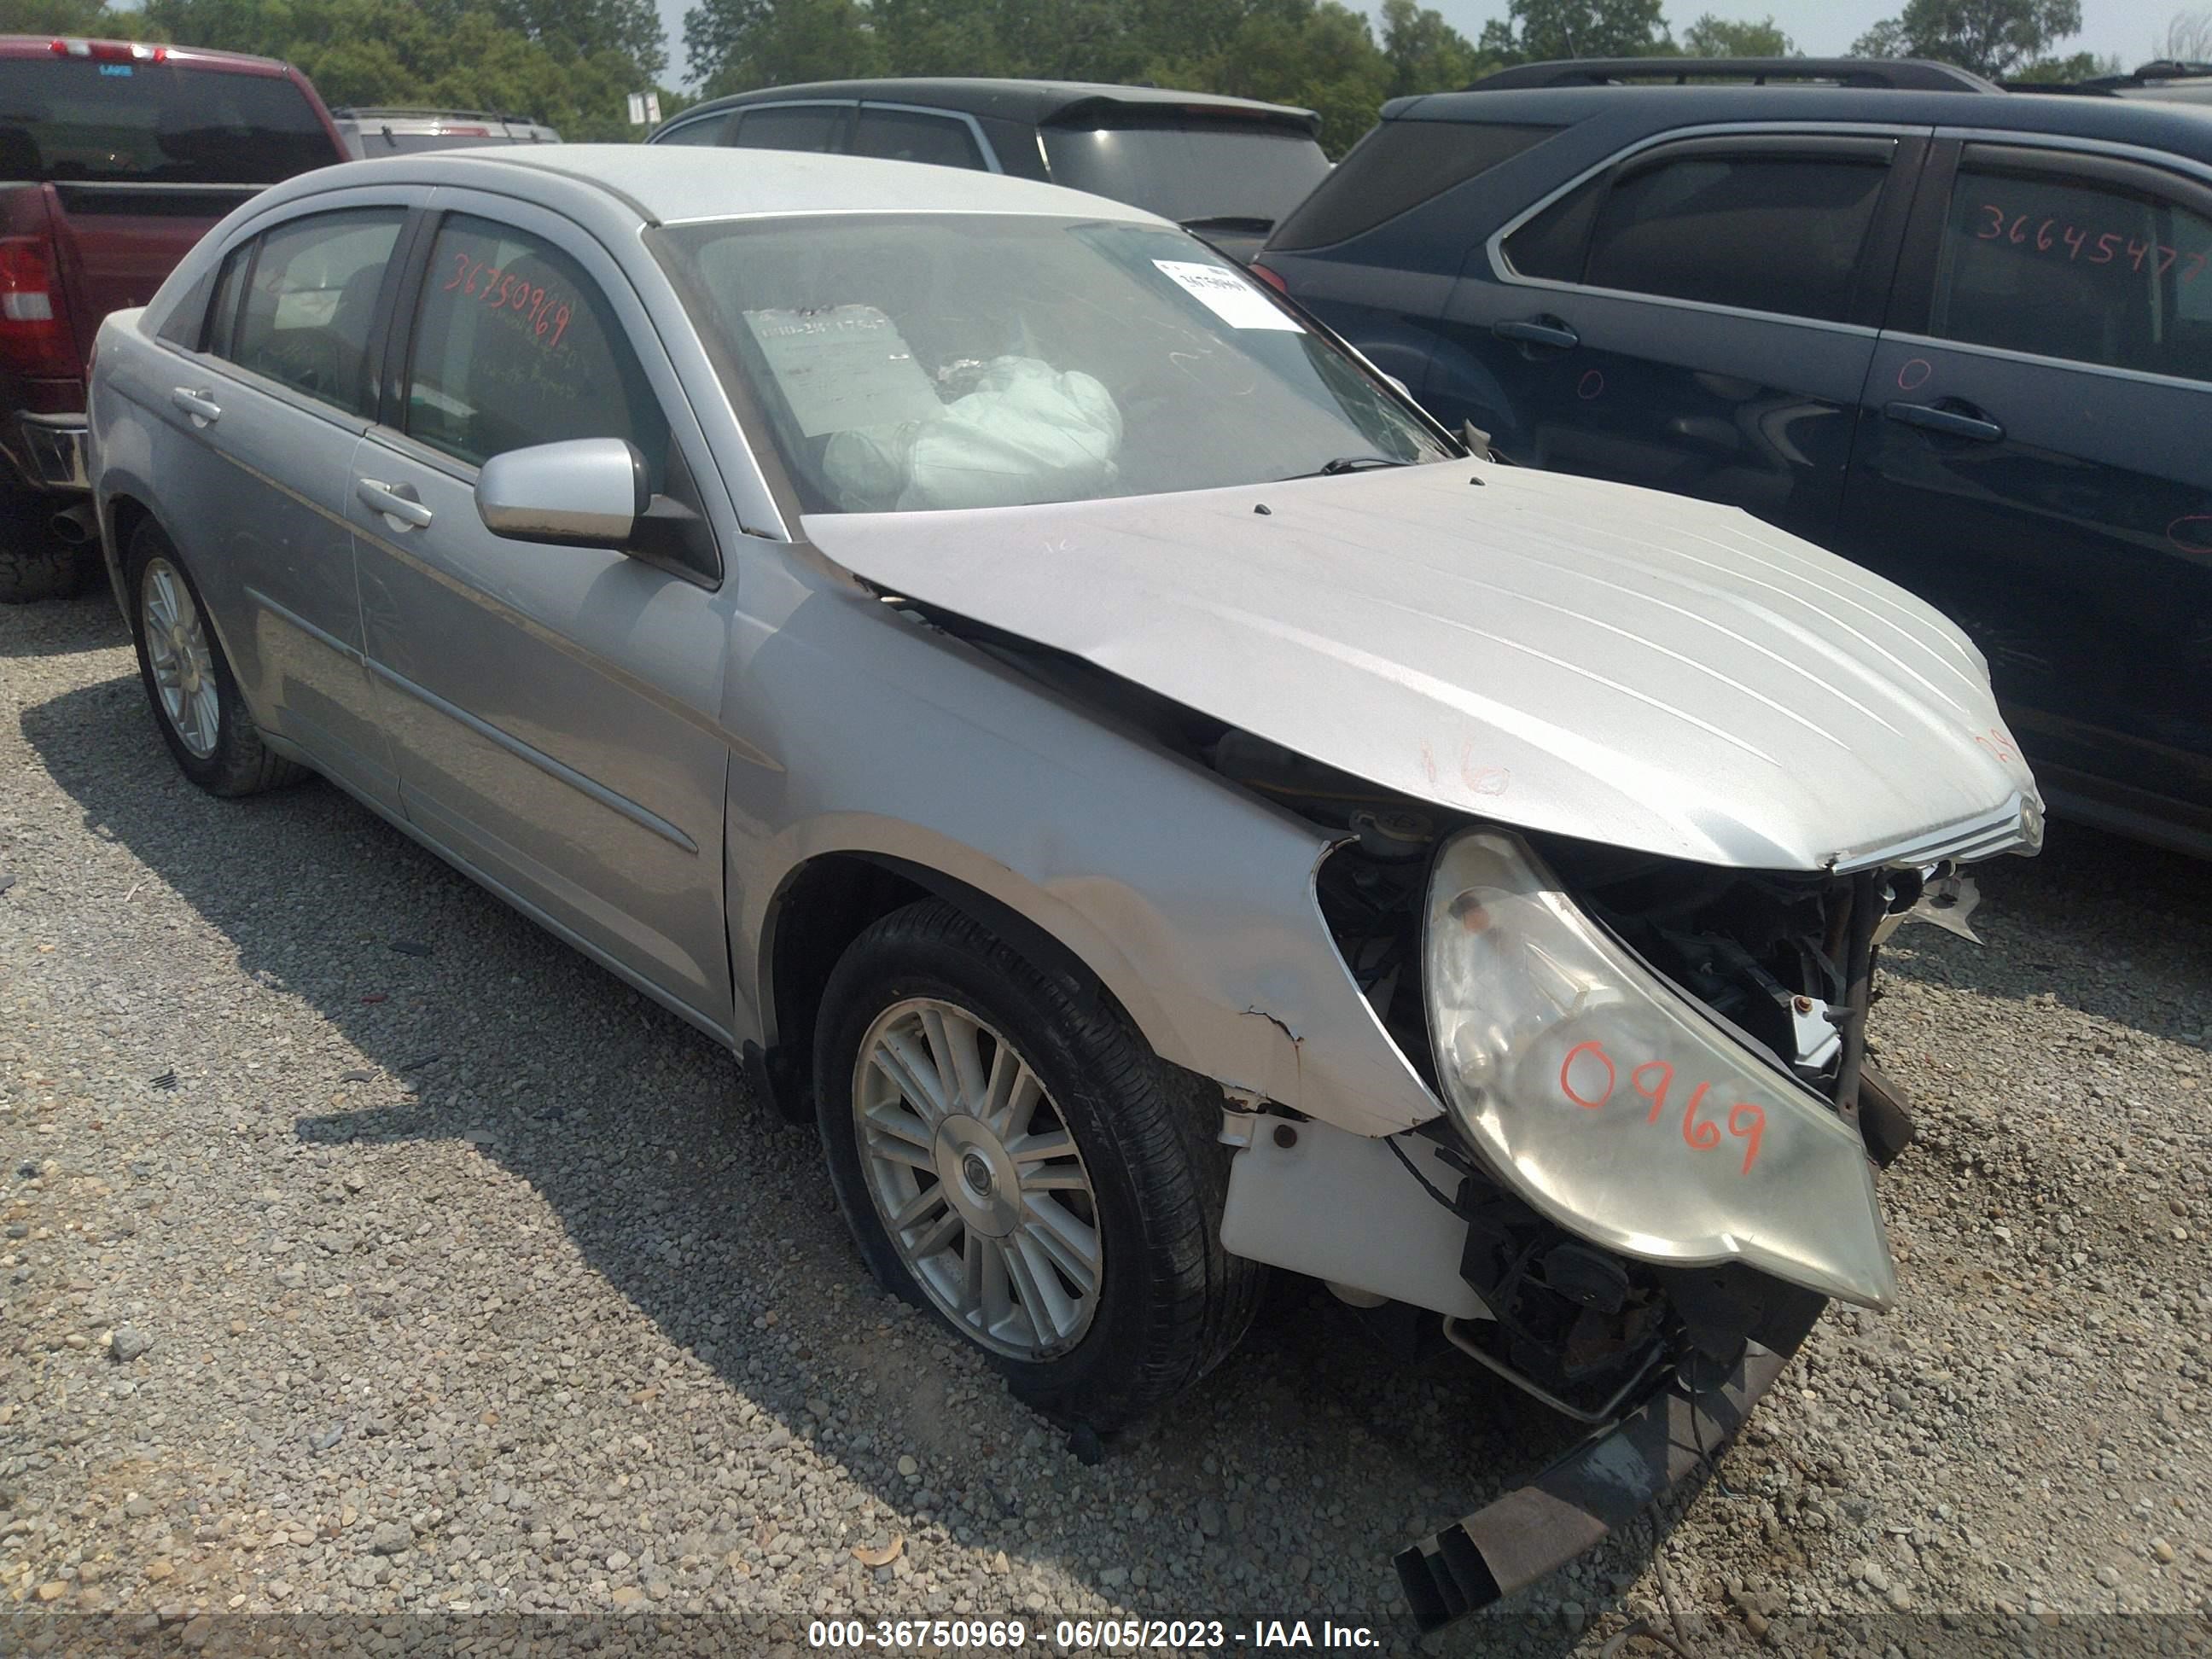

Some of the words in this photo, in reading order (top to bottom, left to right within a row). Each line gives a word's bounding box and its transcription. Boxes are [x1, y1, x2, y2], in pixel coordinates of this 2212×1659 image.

[1977, 205, 2208, 284] 36645477
[444, 253, 572, 347] 36750969
[1560, 1040, 1766, 1176] 0969
